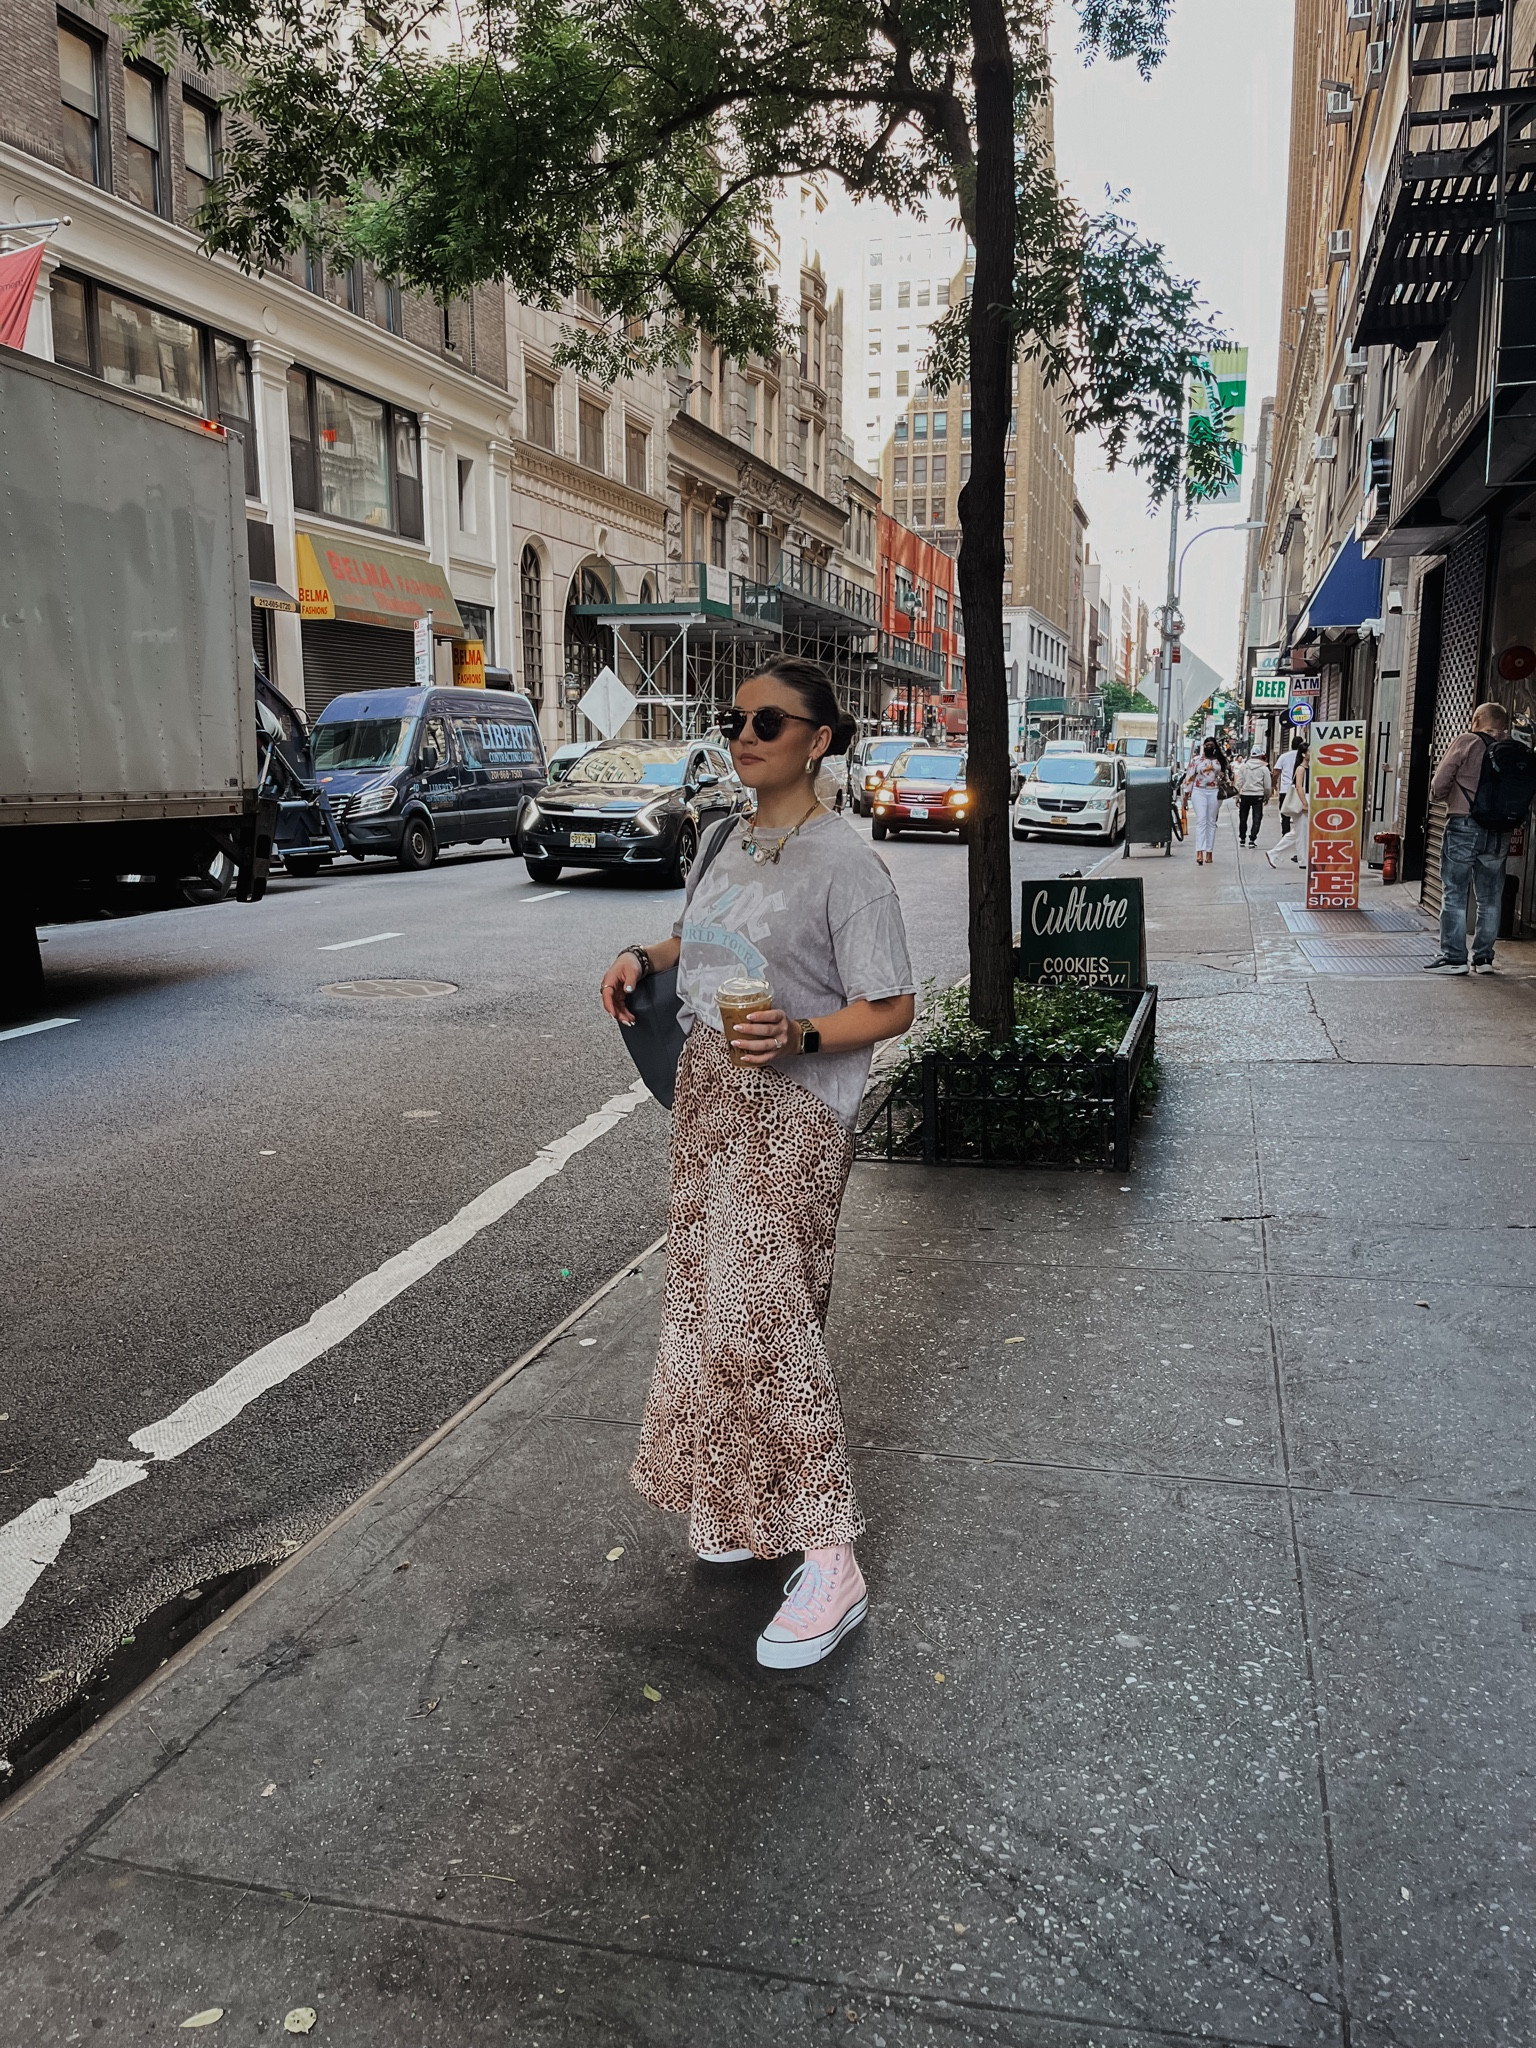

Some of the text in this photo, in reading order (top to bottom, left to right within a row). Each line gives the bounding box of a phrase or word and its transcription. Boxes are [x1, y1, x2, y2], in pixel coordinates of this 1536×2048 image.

[326, 550, 394, 590] BELMA
[299, 587, 329, 602] BELMA
[301, 605, 328, 615] FASHIONS
[453, 647, 482, 666] BELMA
[457, 673, 481, 684] FASHIONS
[1294, 678, 1320, 690] ATM
[1255, 680, 1286, 698] BEER
[477, 723, 535, 750] LIBERTY
[1316, 725, 1363, 740] VAPE
[1309, 742, 1360, 895] SMOKE
[1031, 885, 1128, 936] Culture
[1308, 895, 1356, 909] shop
[722, 932, 754, 966] TOUR
[1043, 956, 1110, 974] COOKIES
